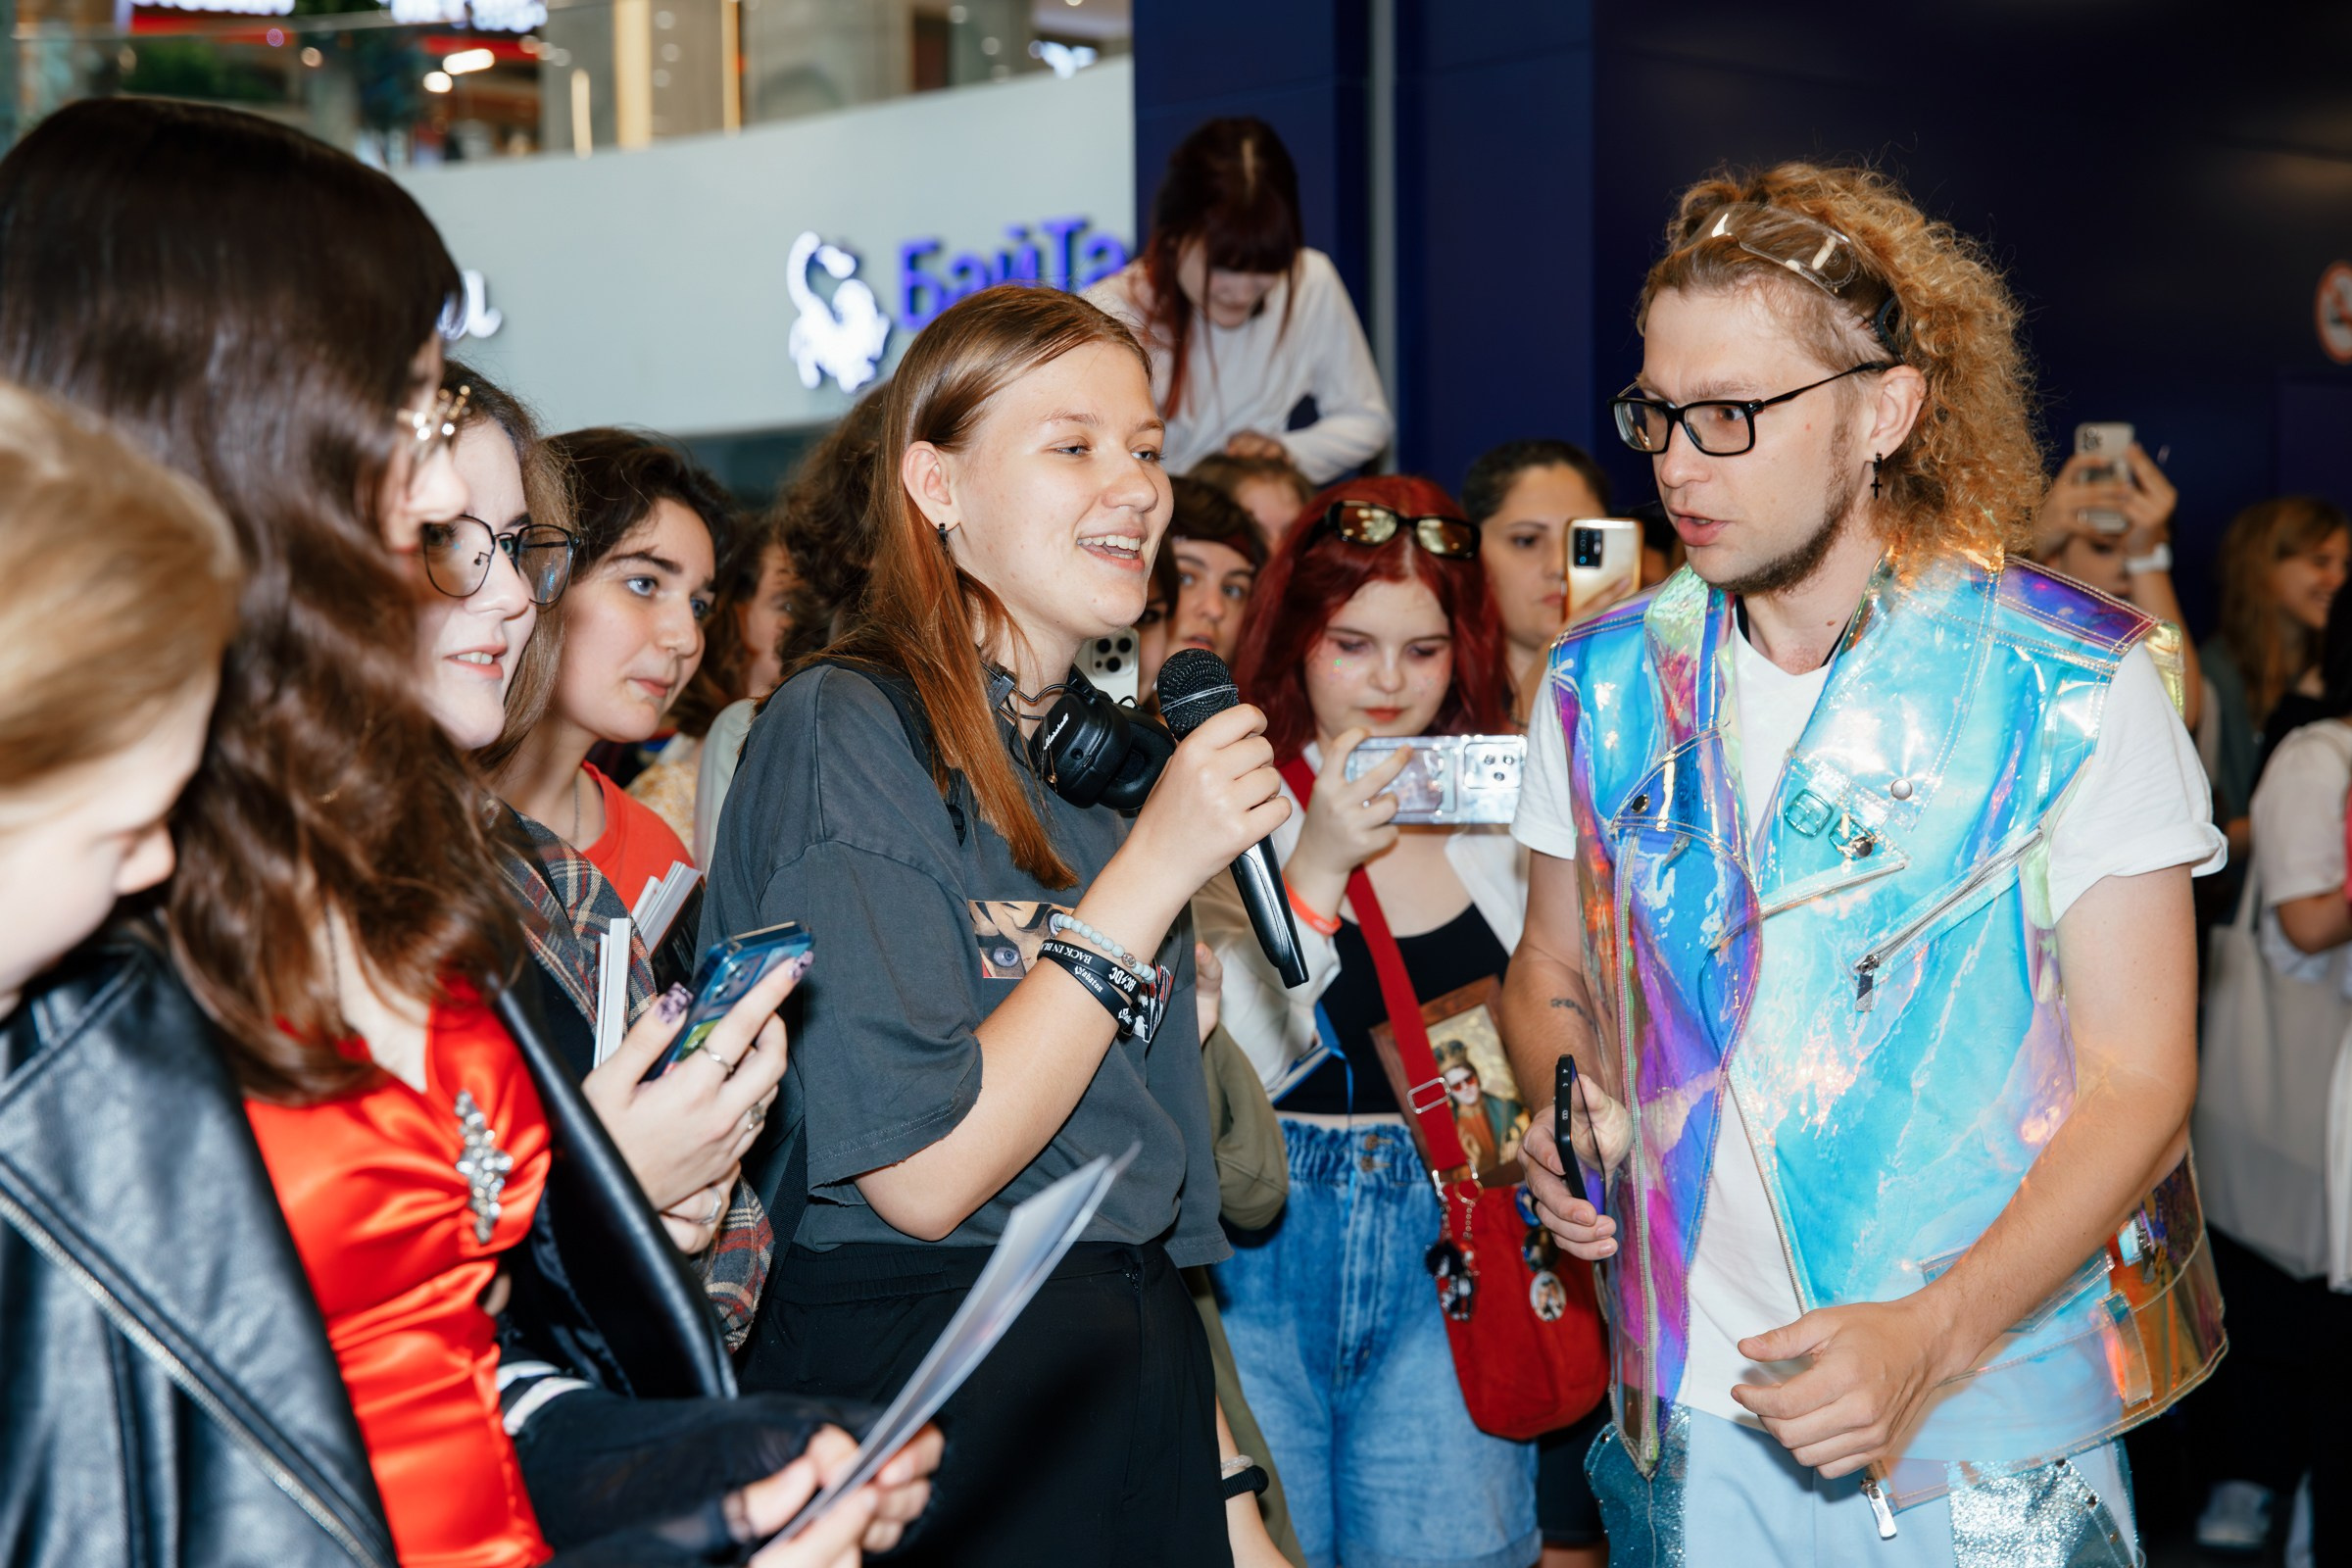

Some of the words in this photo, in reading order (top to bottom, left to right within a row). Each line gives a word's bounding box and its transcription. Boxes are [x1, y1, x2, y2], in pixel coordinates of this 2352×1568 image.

[1044, 712, 1069, 751] Marshall
[1054, 945, 1064, 955] IN
[1064, 948, 1093, 964] BACK
[1074, 965, 1103, 993] Sabaton
[1108, 967, 1137, 992] AC/DC
